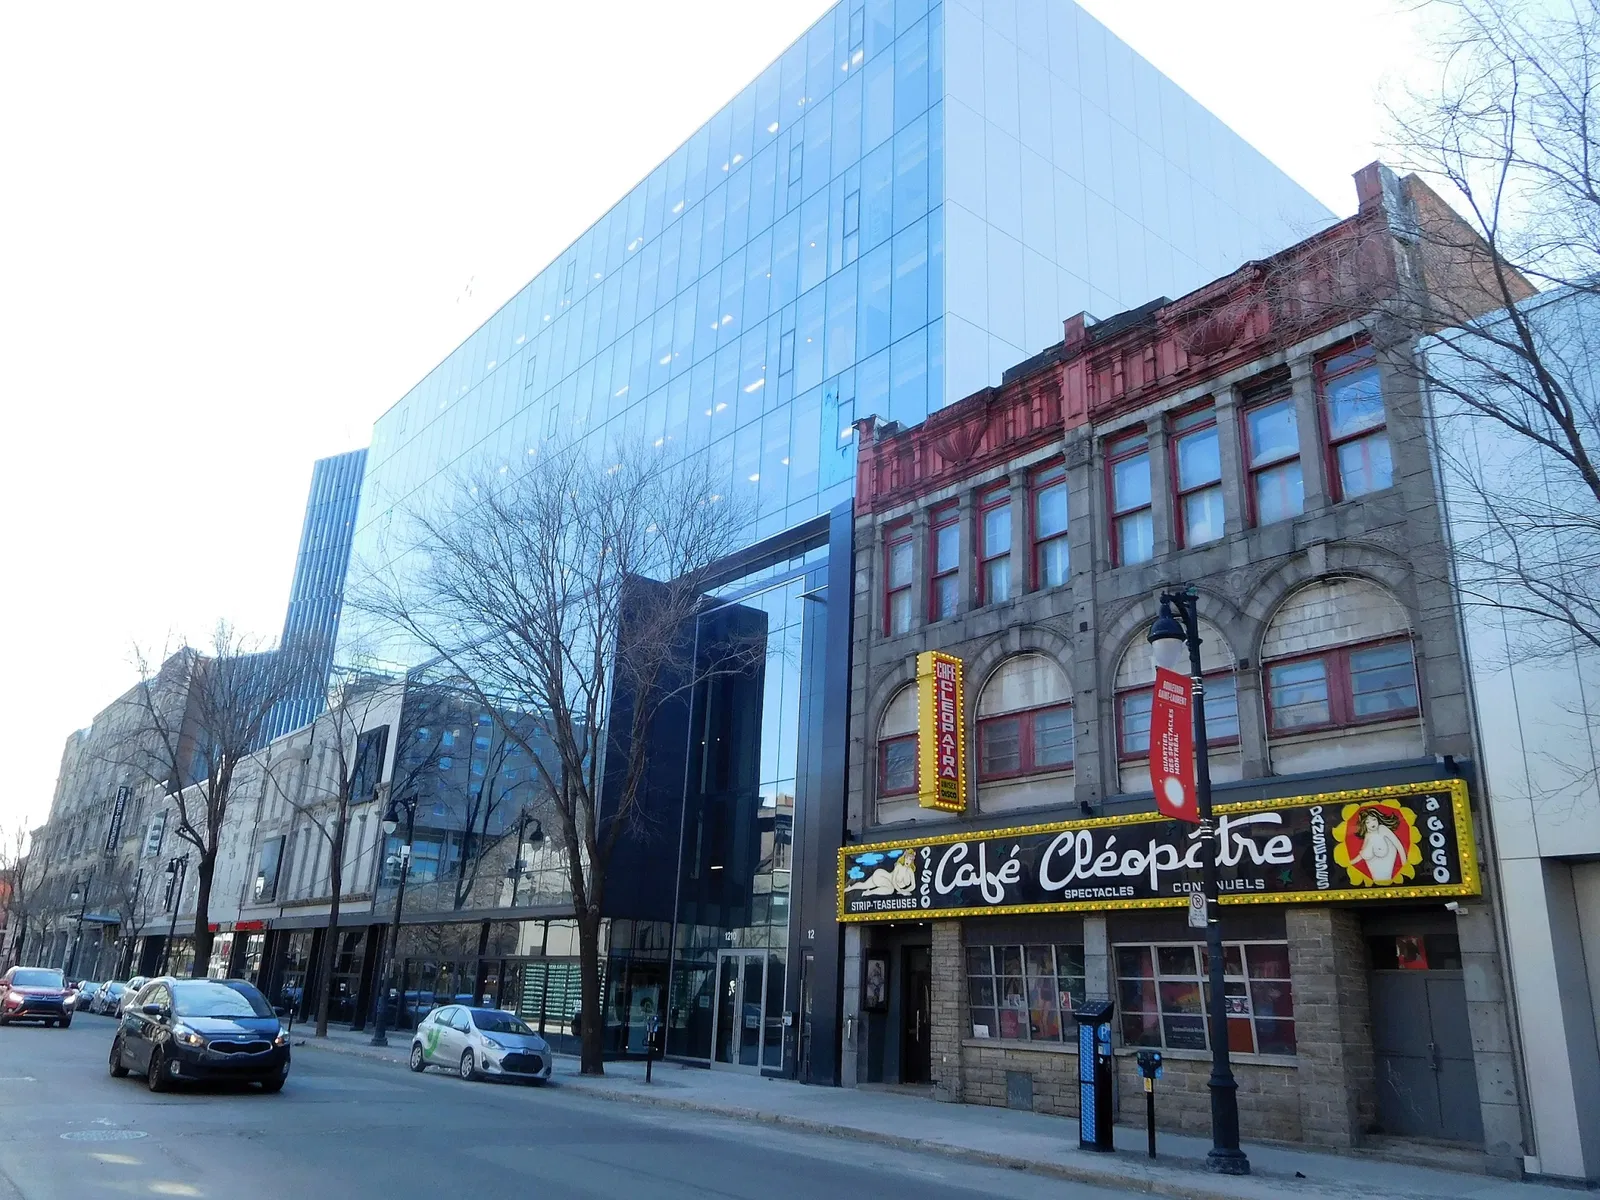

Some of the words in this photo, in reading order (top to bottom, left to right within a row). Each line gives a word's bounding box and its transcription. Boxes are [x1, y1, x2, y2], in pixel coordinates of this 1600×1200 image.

[941, 681, 956, 778] CLEOPATRA
[941, 789, 957, 799] DISCO
[1309, 805, 1330, 890] DANSEUSES
[1426, 815, 1450, 884] GOGO
[920, 846, 933, 909] DISCO
[934, 842, 1021, 904] Café
[1064, 886, 1134, 899] SPECTACLES
[1172, 878, 1265, 893] CONNUELS
[851, 898, 917, 911] STRIP-TEASEUSES
[725, 931, 737, 941] 1210
[807, 929, 815, 939] 12
